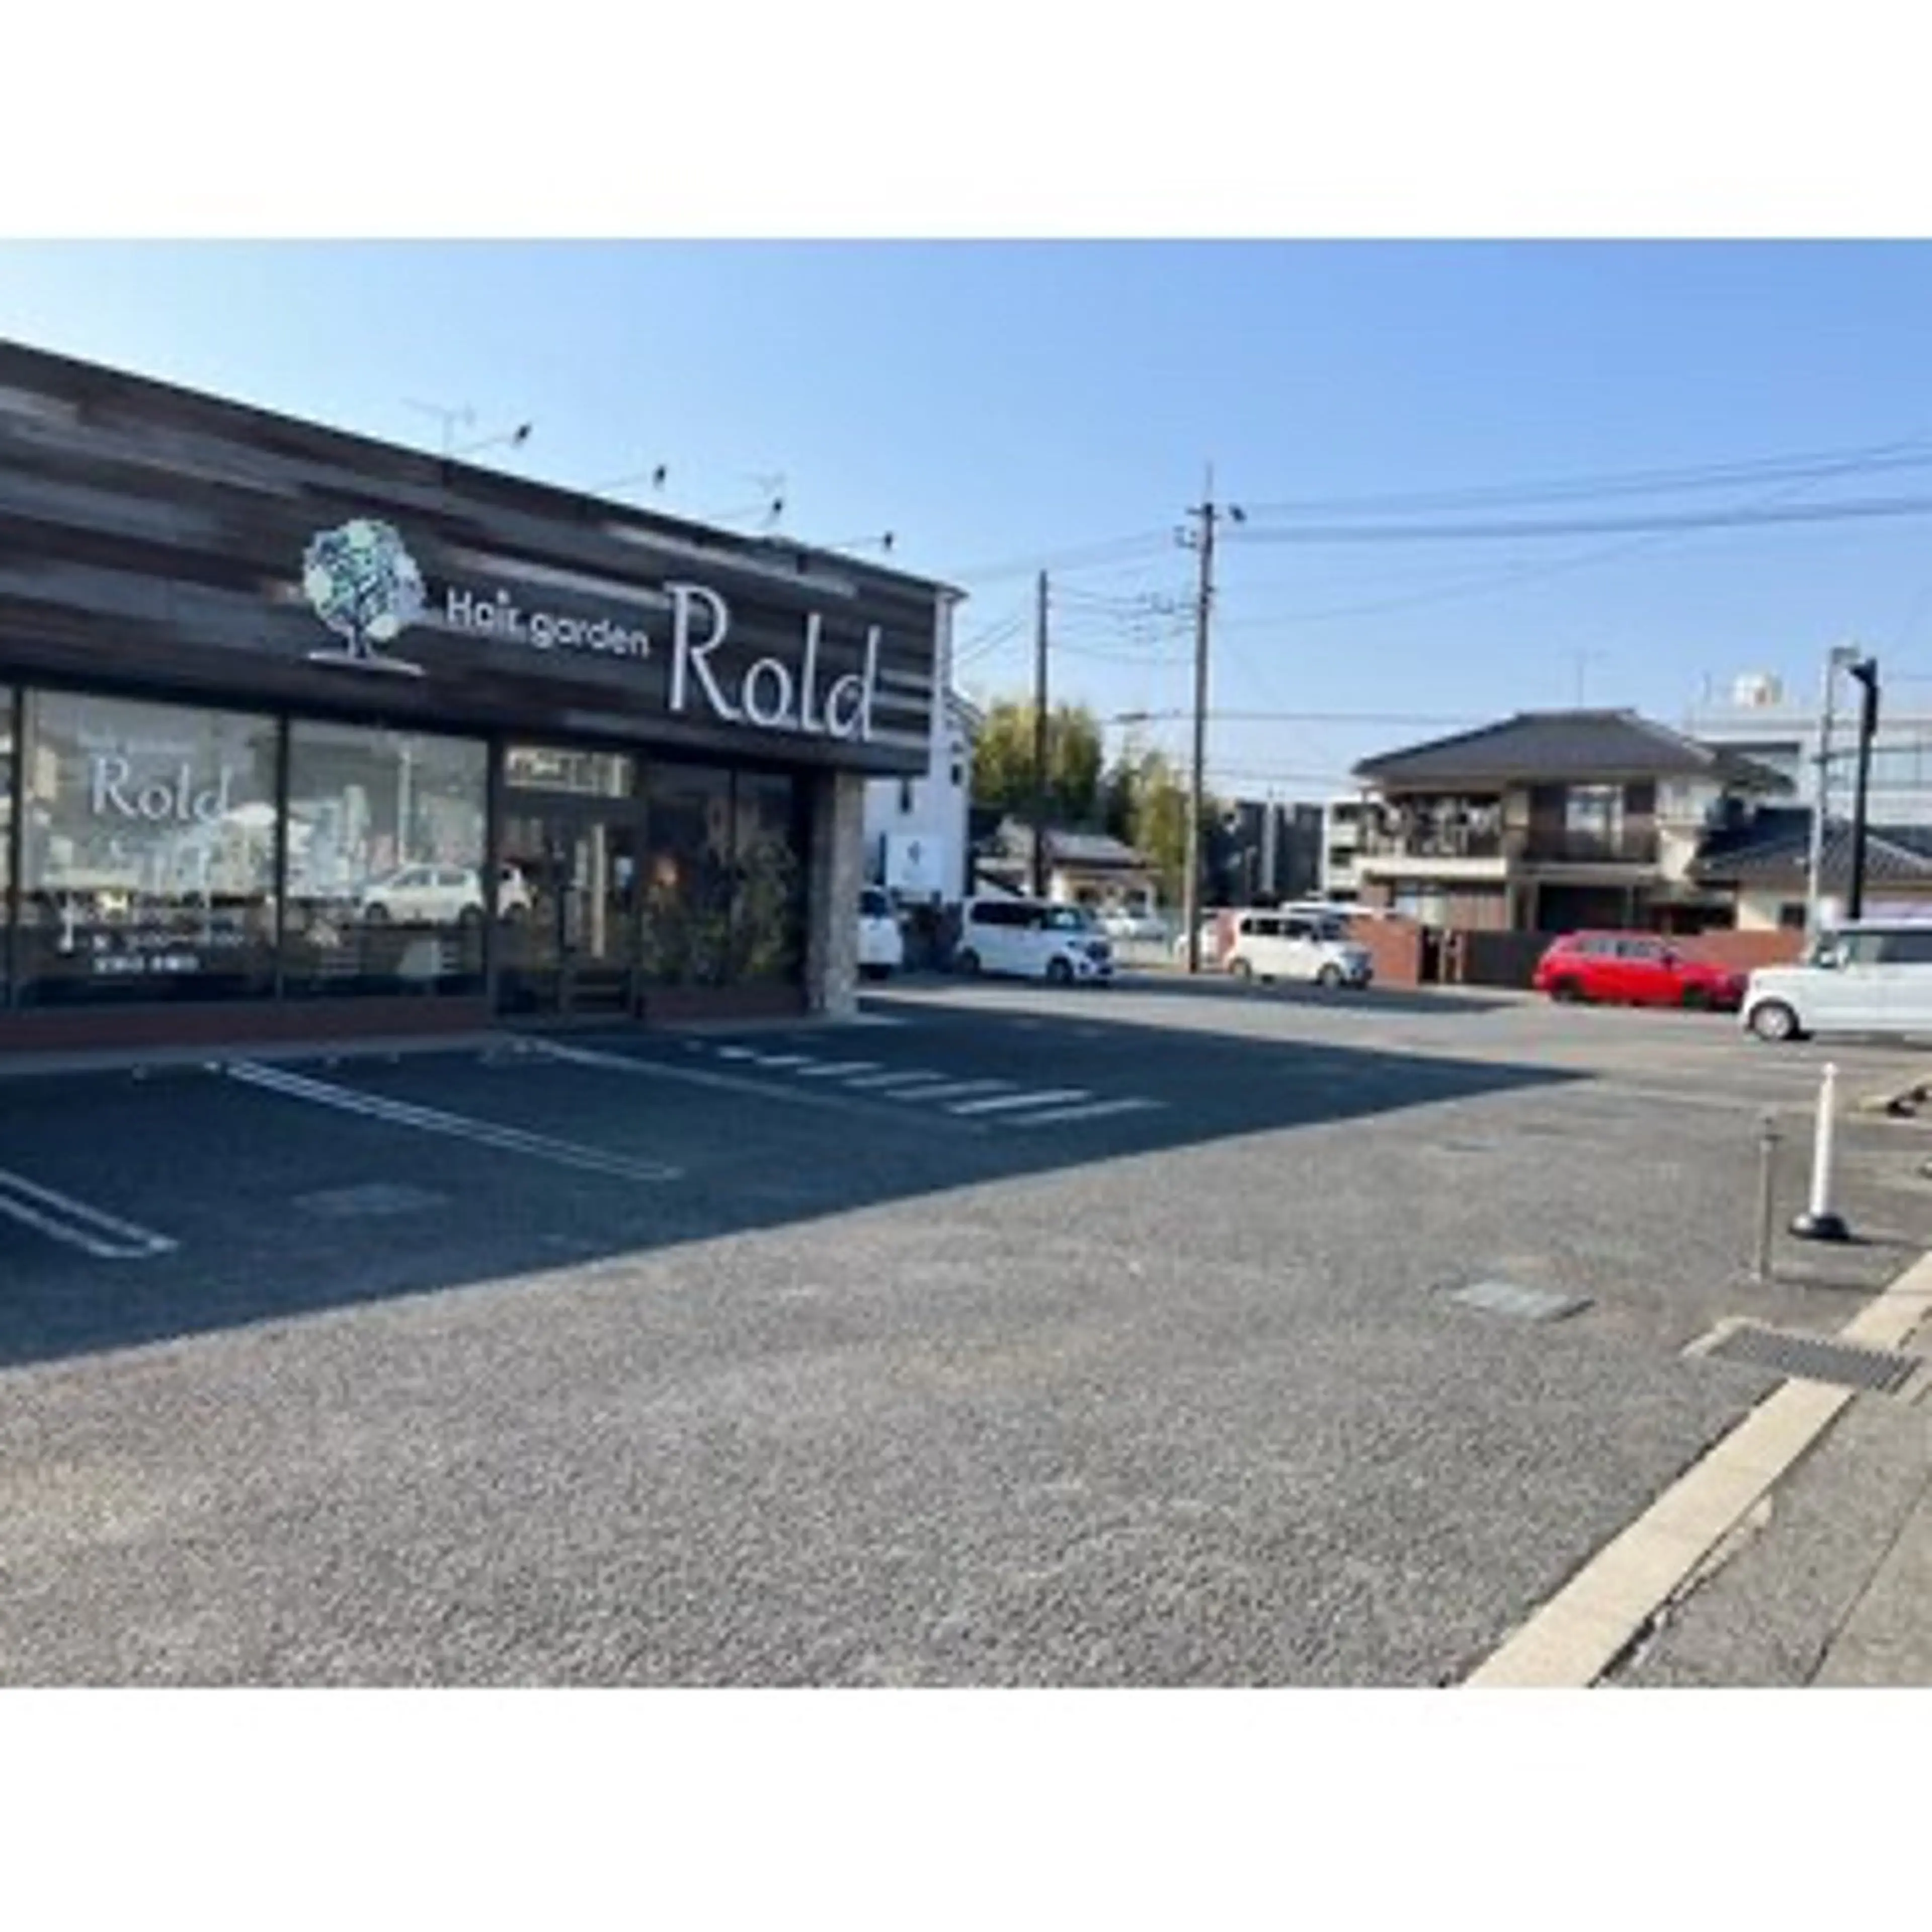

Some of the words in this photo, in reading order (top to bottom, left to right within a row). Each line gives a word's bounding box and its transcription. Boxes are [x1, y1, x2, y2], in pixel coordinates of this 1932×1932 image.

[446, 586, 521, 633] Hair
[530, 612, 650, 659] garden
[664, 581, 881, 742] Rold
[92, 756, 232, 825] Rold
